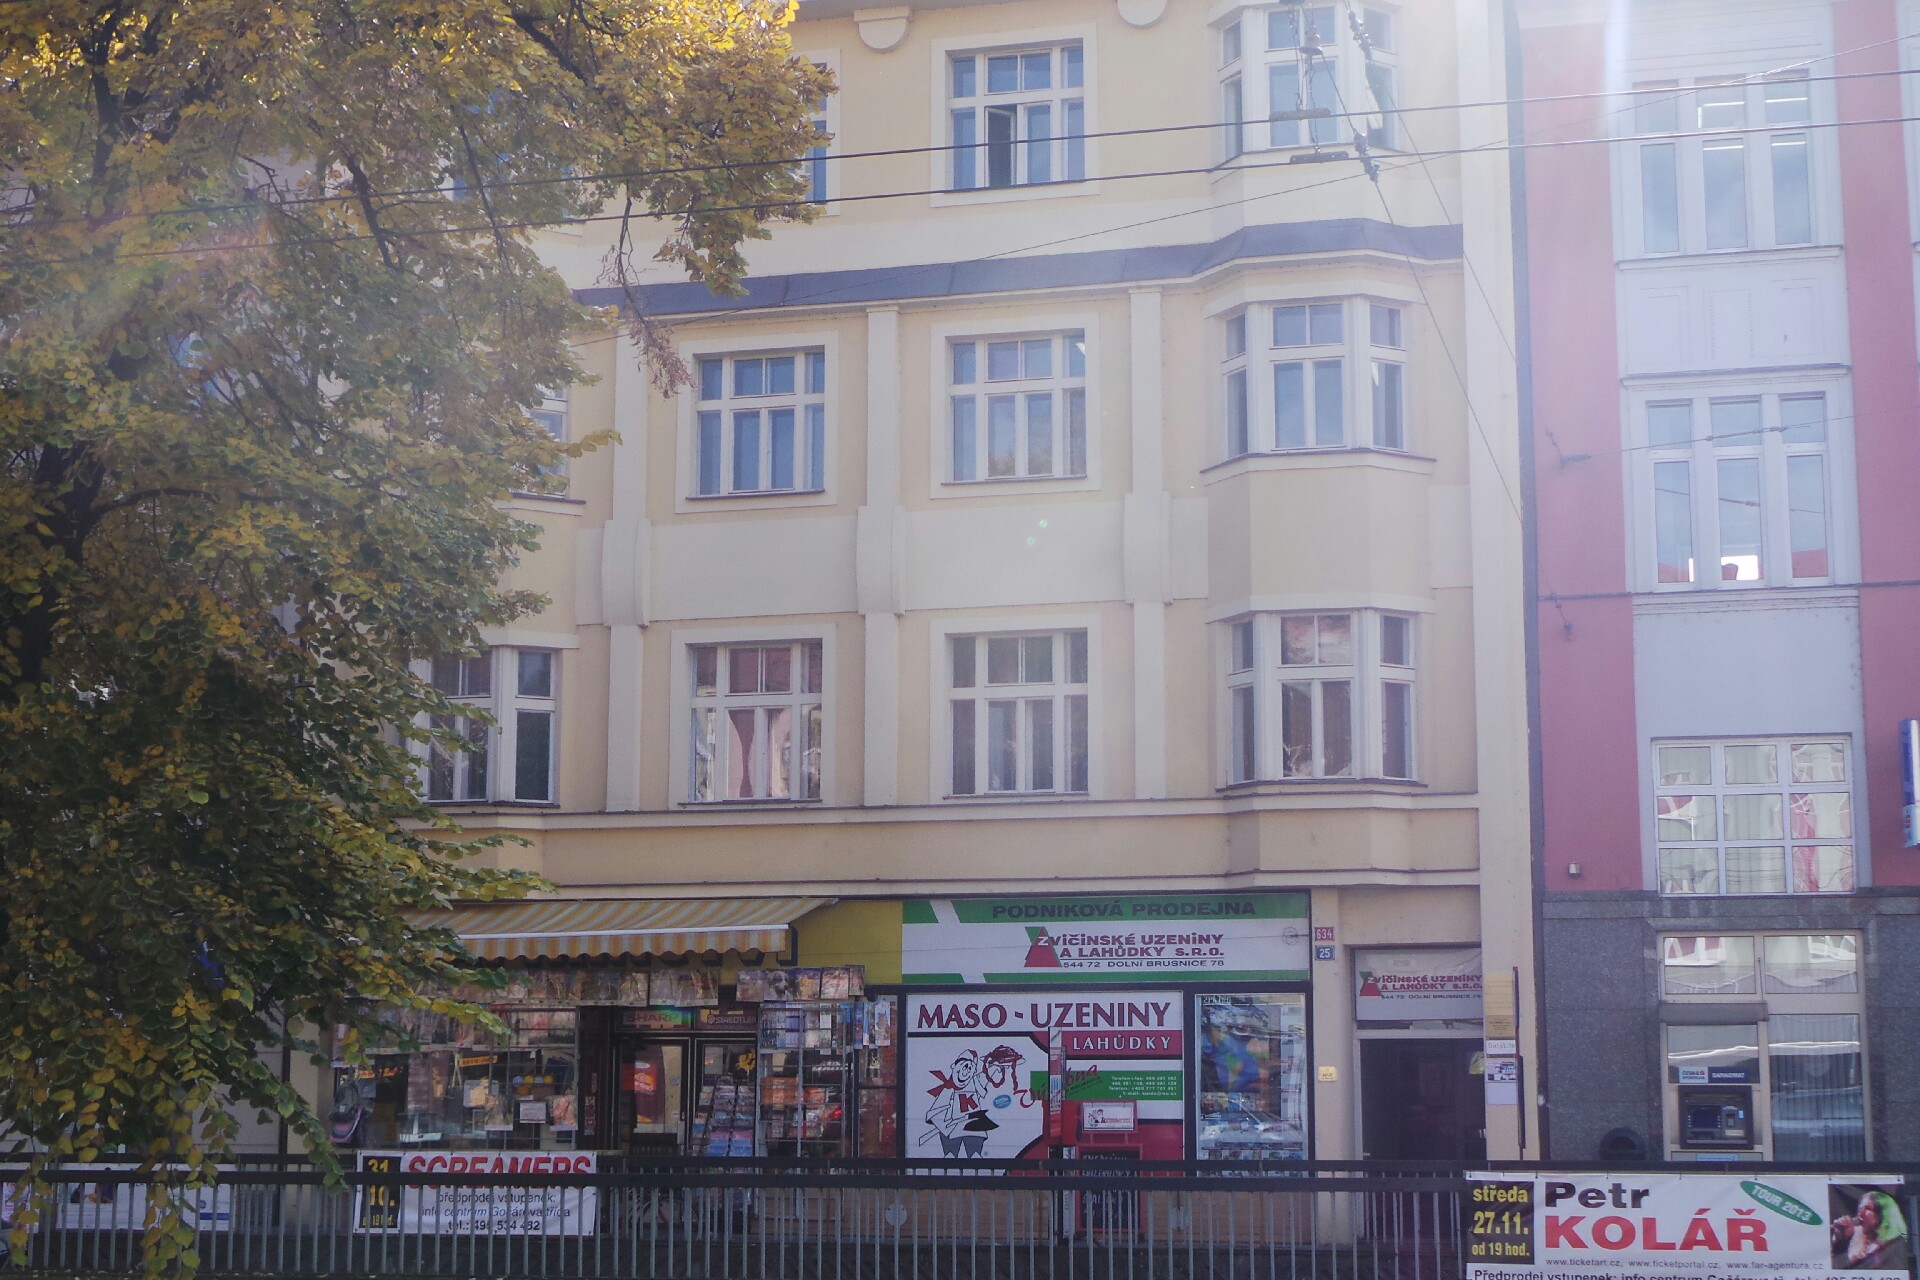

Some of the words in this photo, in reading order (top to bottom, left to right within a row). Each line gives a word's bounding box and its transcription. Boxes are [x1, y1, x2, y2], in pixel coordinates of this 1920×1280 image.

[992, 900, 1124, 918] PODNIKOVÁ
[1132, 902, 1256, 917] PRODEJNA
[1316, 929, 1332, 940] 634
[1060, 948, 1072, 958] A
[1078, 945, 1165, 958] LAHŮDKY
[1175, 947, 1225, 957] S.R.O.
[1319, 948, 1331, 959] 25
[1107, 959, 1142, 968] DOLNÍ
[1210, 959, 1225, 967] 78
[917, 1003, 1008, 1028] MASO
[1031, 1002, 1171, 1028] UZENINY
[1073, 1033, 1172, 1050] LAHŮDKY
[958, 1094, 979, 1114] K
[408, 1156, 591, 1190] SCREAMERS
[1473, 1185, 1529, 1203] středa
[1545, 1182, 1650, 1209] Petr
[1751, 1185, 1781, 1207] TOUR
[1782, 1198, 1812, 1222] 2013
[1473, 1211, 1529, 1235] 27.11.
[1545, 1208, 1769, 1252] KOLÁŘ
[1472, 1242, 1484, 1256] od
[1489, 1242, 1502, 1256] 19
[1505, 1242, 1530, 1257] hod.
